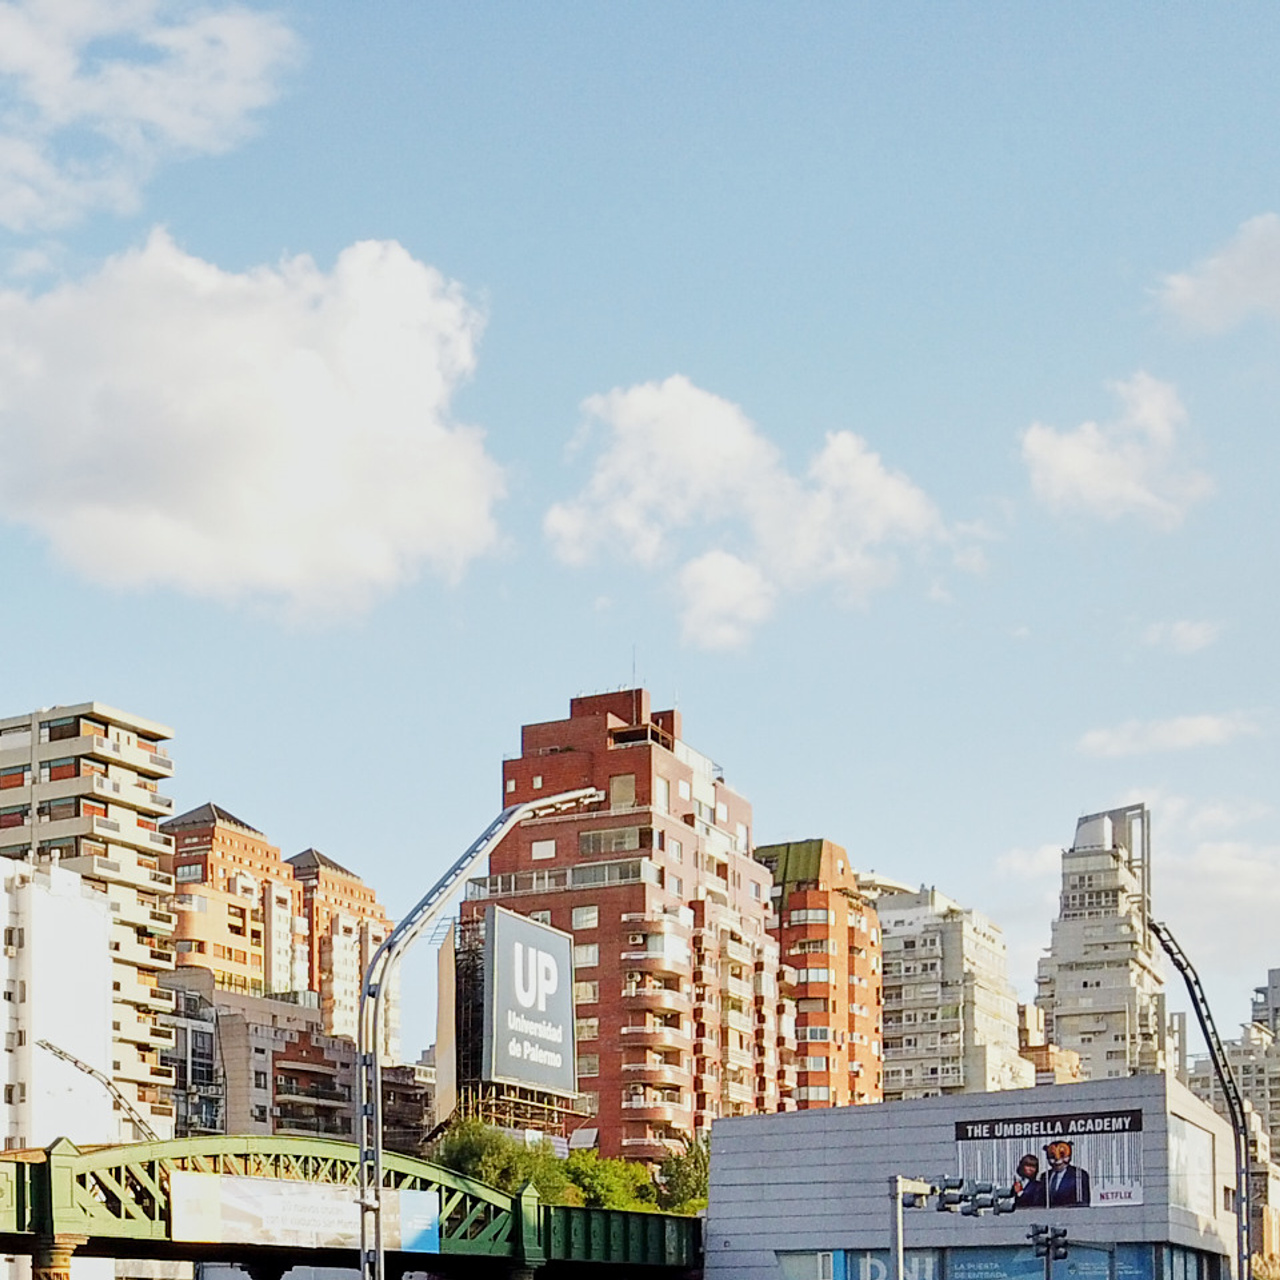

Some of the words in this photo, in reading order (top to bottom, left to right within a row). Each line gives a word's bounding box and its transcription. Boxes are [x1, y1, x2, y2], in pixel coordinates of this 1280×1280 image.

[514, 941, 558, 1012] UP
[507, 1009, 563, 1043] Universidad
[508, 1037, 522, 1058] de
[523, 1040, 562, 1068] Palermo
[966, 1124, 990, 1138] THE
[995, 1120, 1063, 1137] UMBRELLA
[1068, 1116, 1132, 1133] ACADEMY
[1099, 1190, 1132, 1200] NETFLIX
